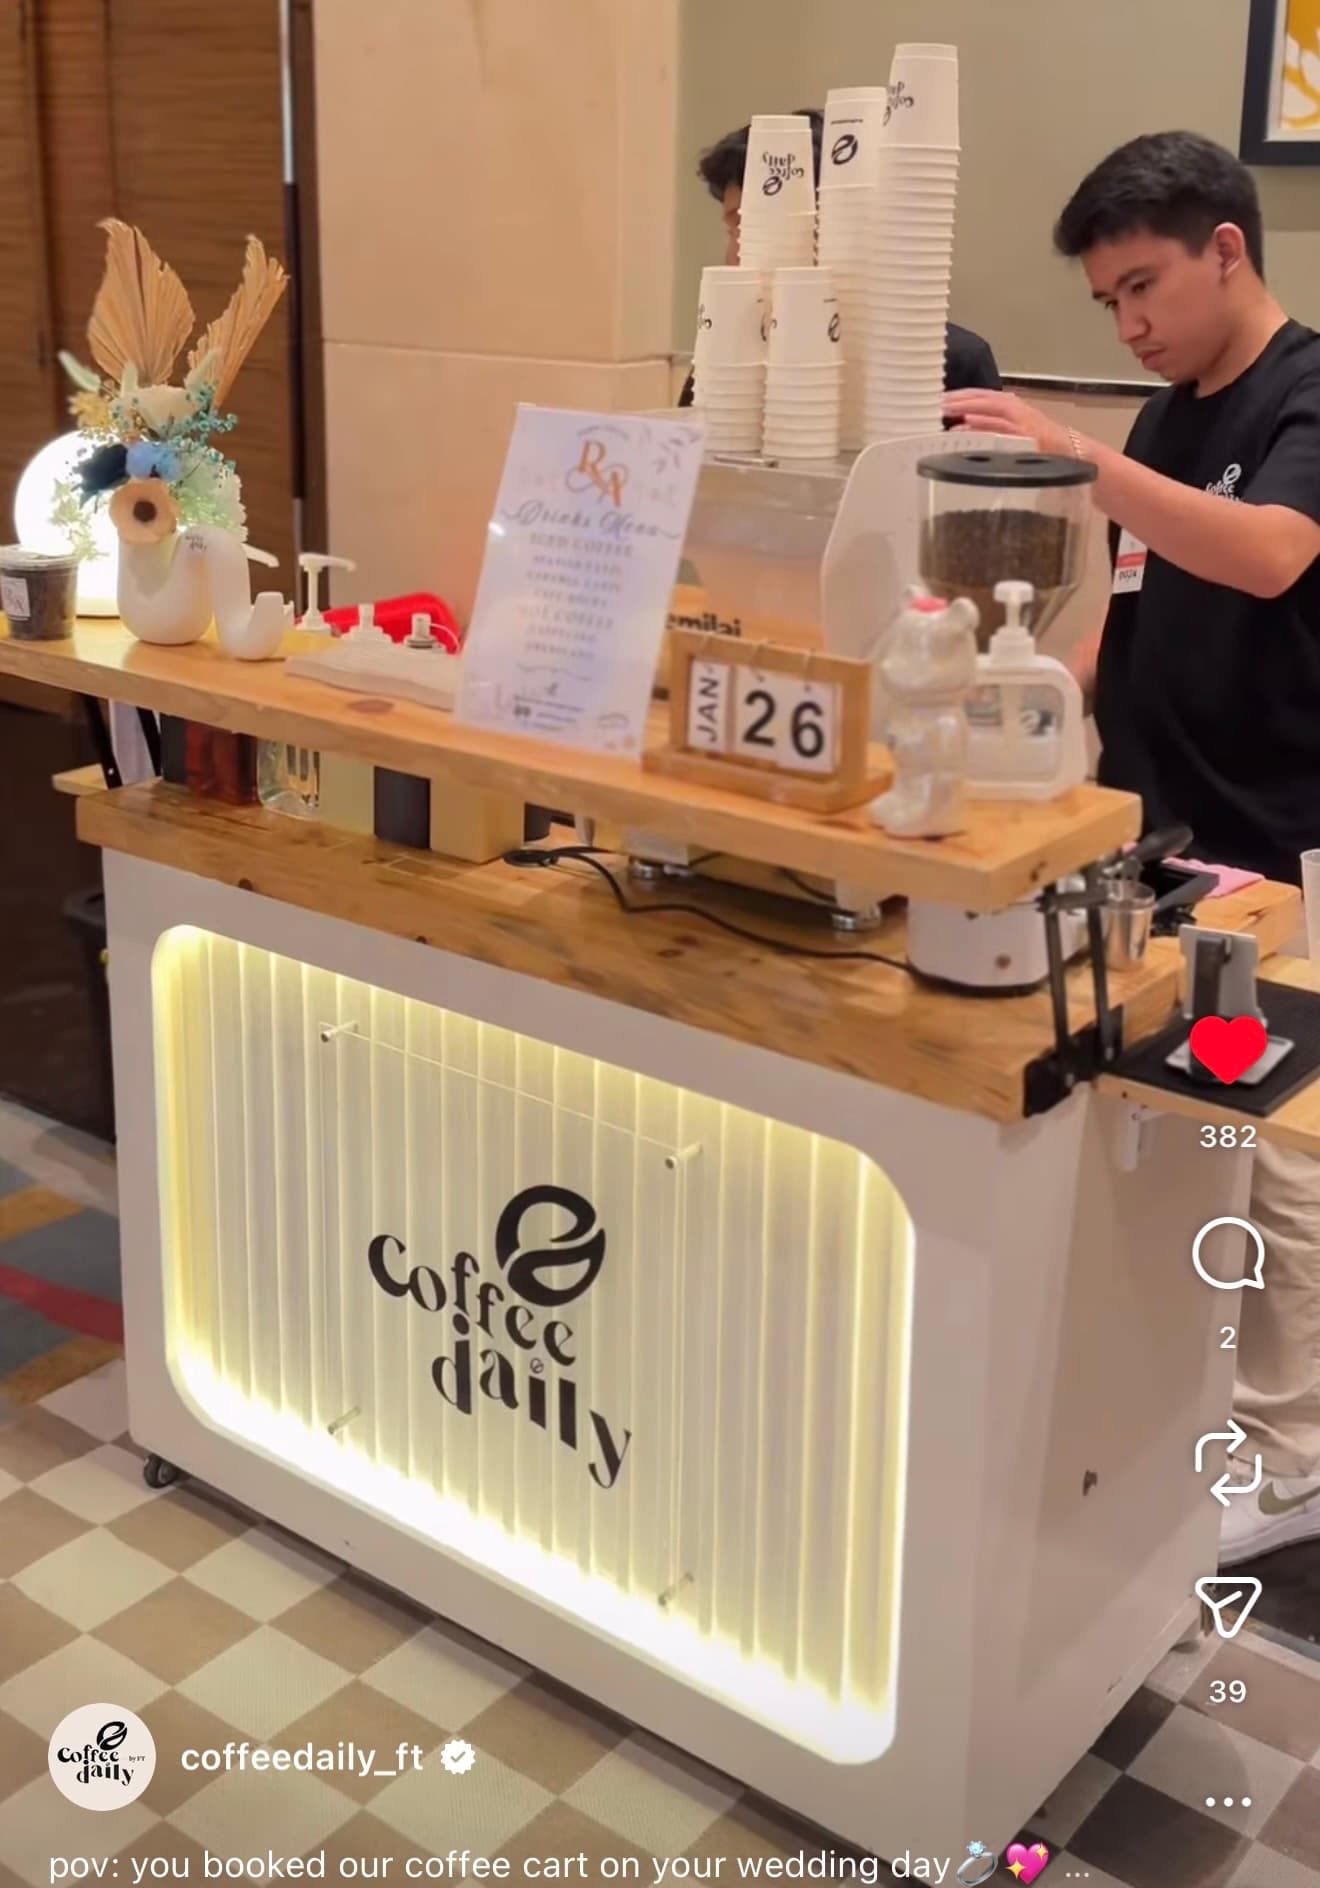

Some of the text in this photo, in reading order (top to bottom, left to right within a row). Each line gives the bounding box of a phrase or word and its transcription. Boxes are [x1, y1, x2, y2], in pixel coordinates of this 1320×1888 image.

[697, 676, 719, 742] JAN
[368, 1234, 576, 1366] Coffee
[432, 1316, 632, 1489] daily
